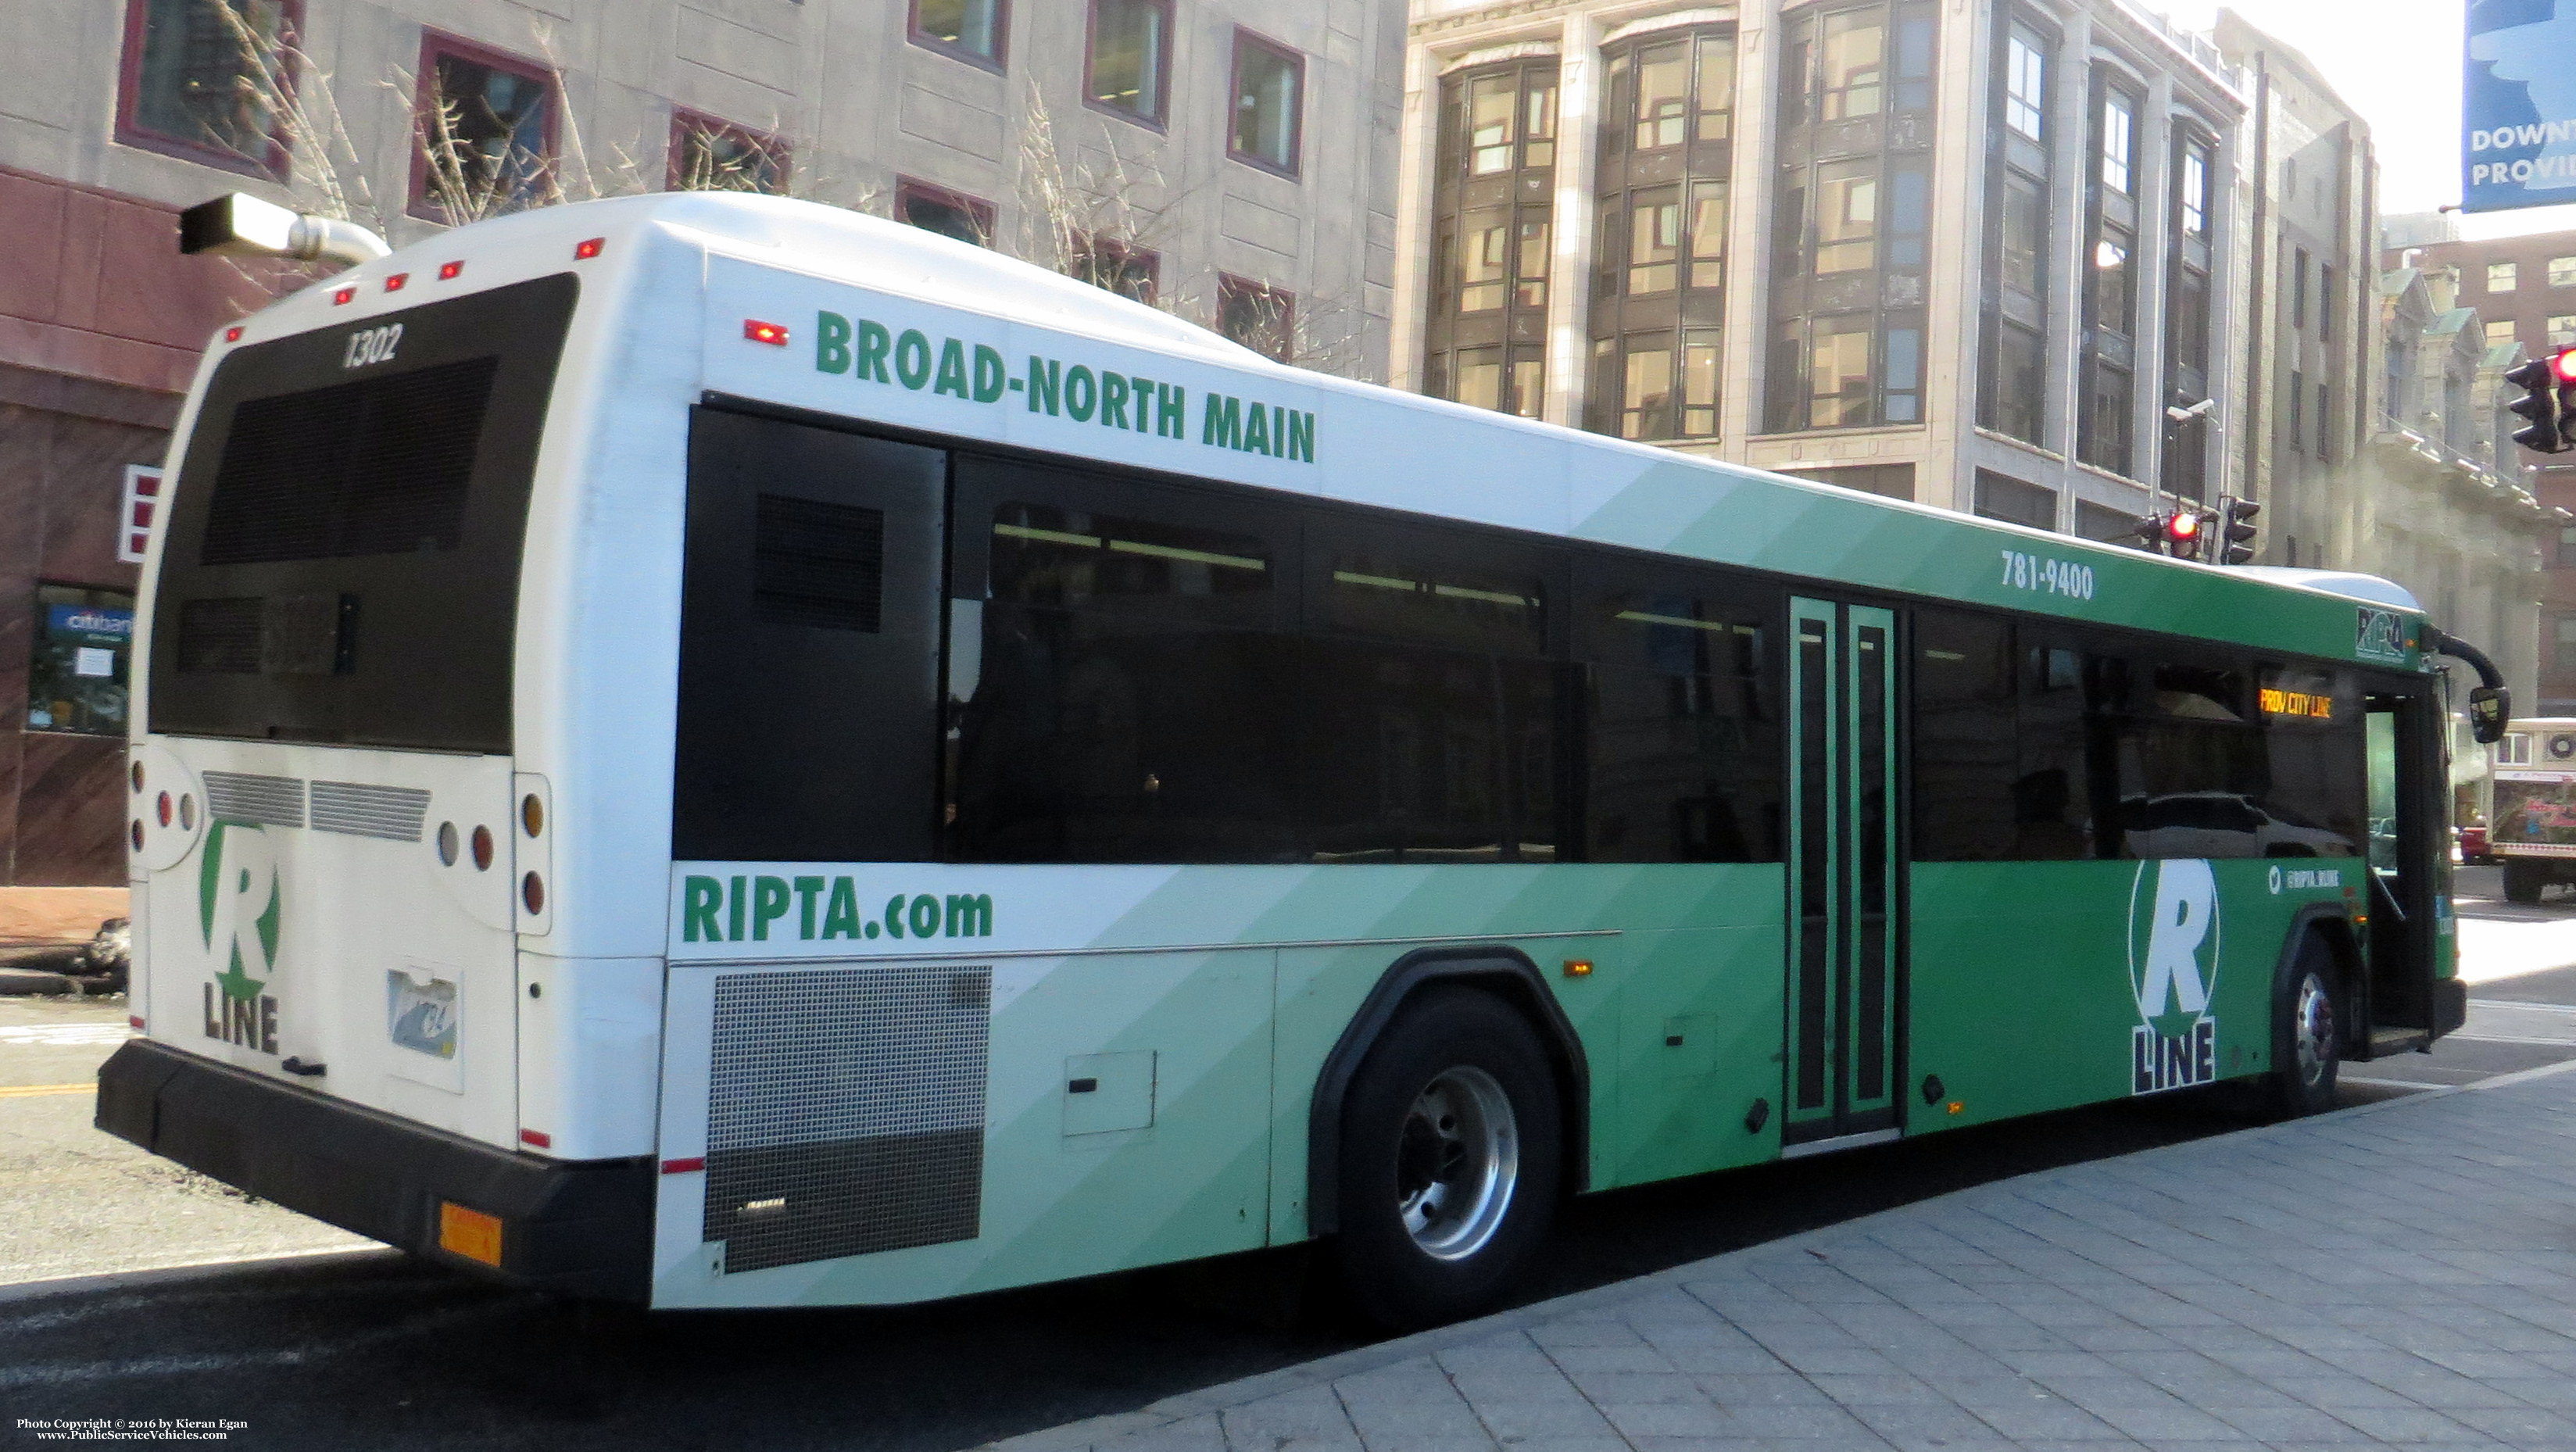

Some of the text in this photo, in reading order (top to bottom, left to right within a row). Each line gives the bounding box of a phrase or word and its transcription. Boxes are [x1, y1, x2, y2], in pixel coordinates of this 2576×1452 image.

[343, 321, 404, 368] 1302
[817, 309, 1315, 463] BROAD-NORTH MAIN
[2002, 549, 2094, 600] 781-9400
[67, 613, 133, 634] citiban
[2288, 692, 2312, 716] CITY
[2309, 695, 2331, 718] LINE
[207, 823, 277, 978] R
[682, 874, 993, 942] RIPTA.com
[2140, 859, 2214, 1017] R
[204, 982, 279, 1055] LINE
[2132, 1016, 2215, 1095] LINE
